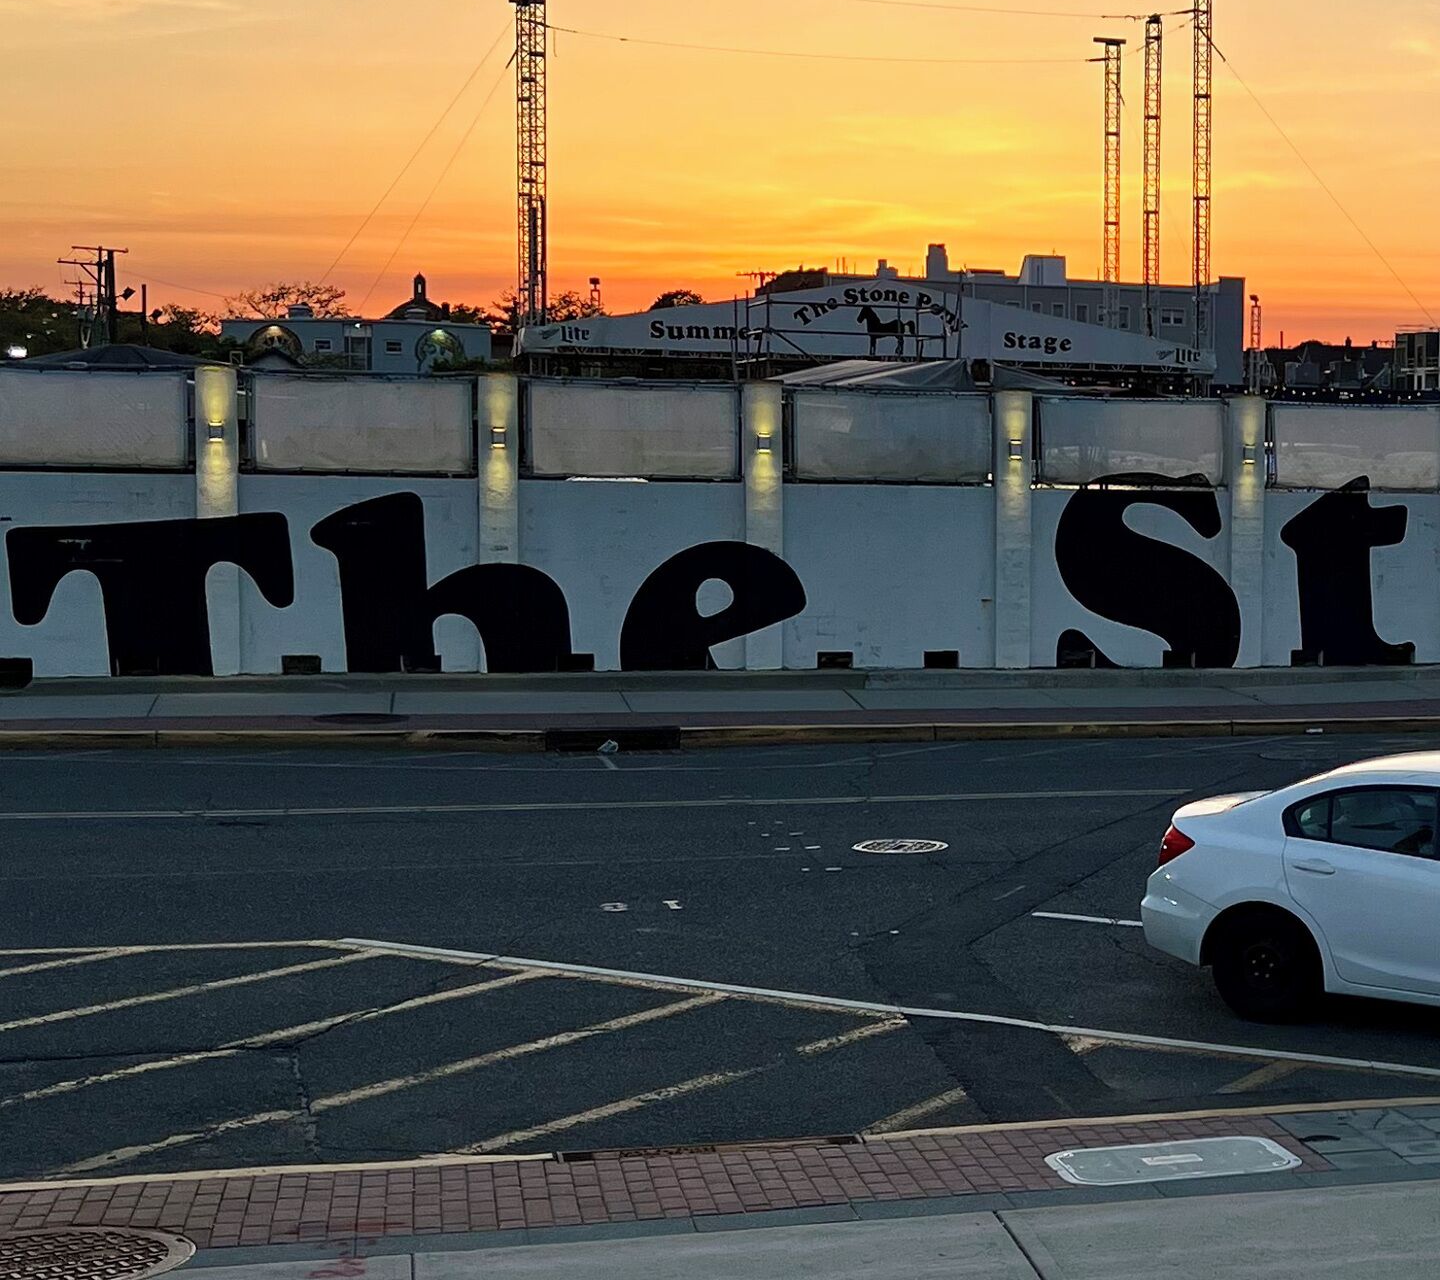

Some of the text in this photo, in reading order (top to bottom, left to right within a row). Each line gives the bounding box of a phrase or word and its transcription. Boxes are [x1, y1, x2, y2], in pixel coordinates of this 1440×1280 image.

[793, 297, 839, 326] The
[843, 287, 910, 305] Stone
[560, 325, 590, 343] Lite
[1003, 331, 1072, 354] Stage
[1175, 348, 1201, 365] Lite
[5, 491, 807, 677] The
